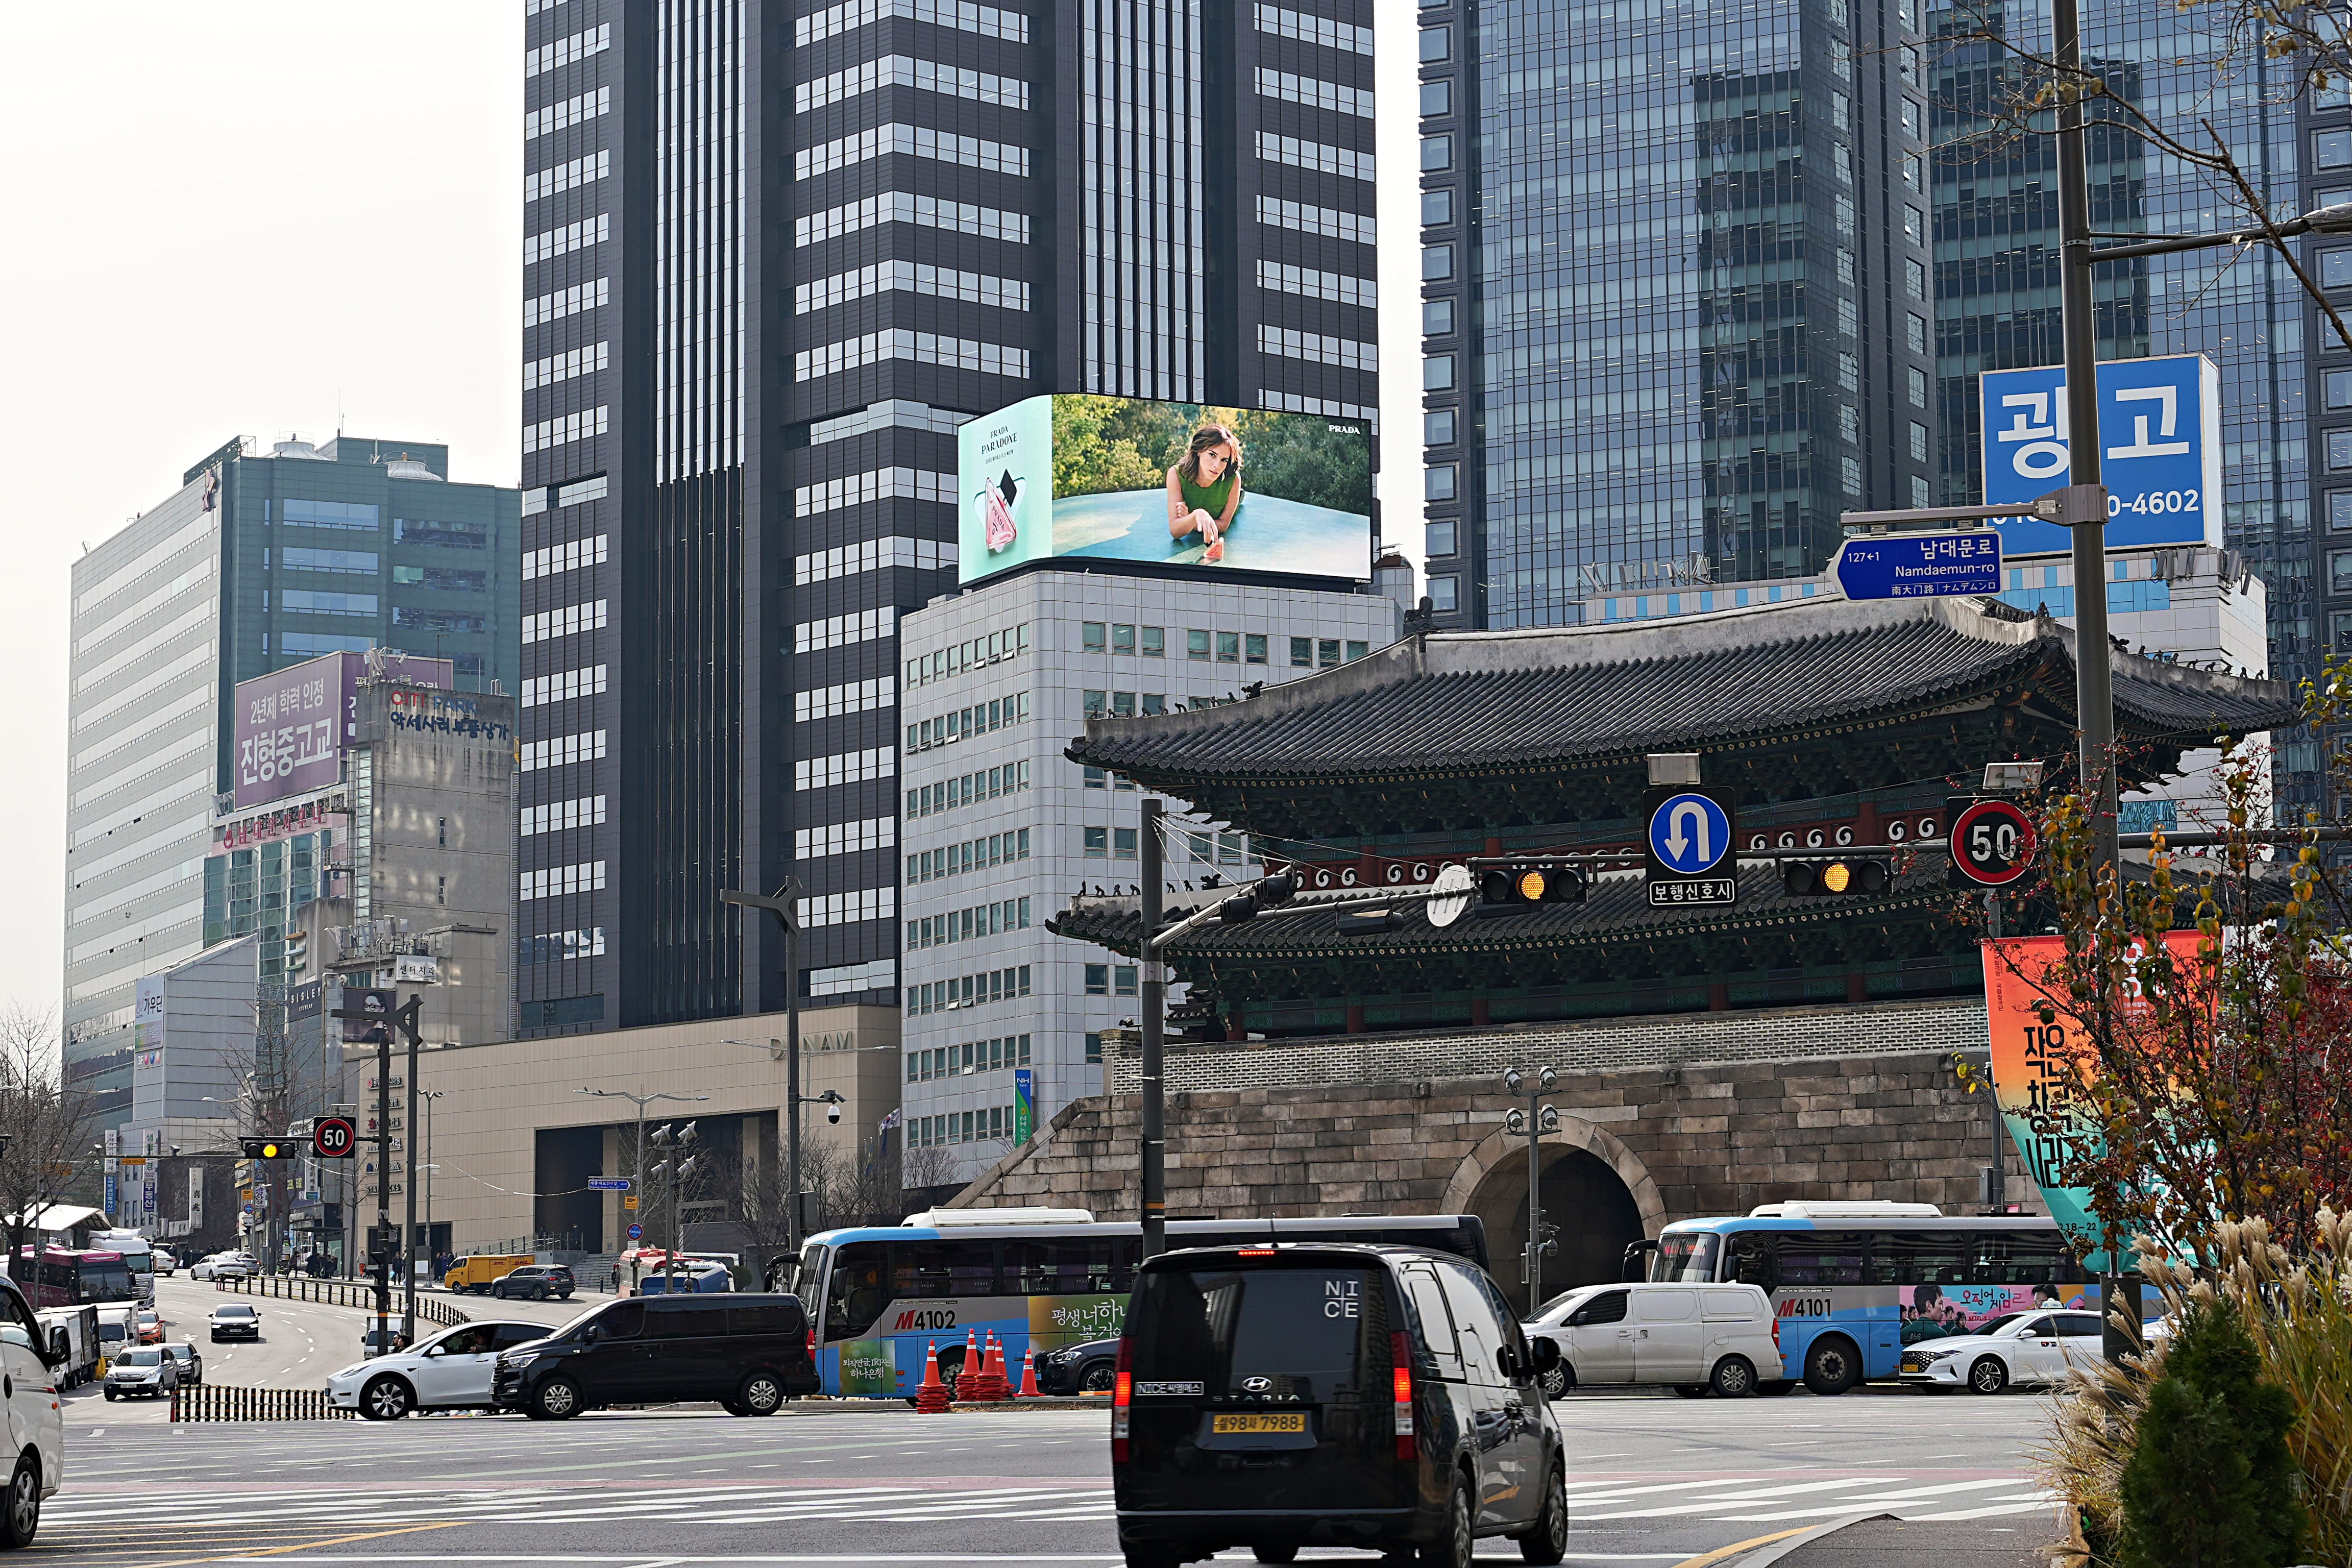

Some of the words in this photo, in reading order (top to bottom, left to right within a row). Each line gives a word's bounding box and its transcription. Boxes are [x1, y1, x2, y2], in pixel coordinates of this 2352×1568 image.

[990, 426, 1008, 438] PRADA
[1329, 425, 1360, 434] PRADA
[982, 432, 1017, 454] PARADOXE
[1921, 539, 1994, 560] 남대문로
[1895, 564, 1995, 577] Namdaemun-ro
[1892, 585, 1934, 596] 南大门路
[251, 692, 276, 724] 2년제
[280, 685, 300, 716] 학력
[303, 677, 324, 709] 인정
[391, 691, 425, 707] CITI
[434, 695, 478, 715] PARK
[390, 712, 450, 735] 악세사리
[240, 718, 333, 786] 진형중고교
[238, 804, 322, 845] 남대문사우나
[1972, 824, 2016, 861] 50
[1655, 883, 1730, 900] 보행신호시
[399, 965, 435, 975] 센터치과
[291, 987, 321, 1003] SISLEY
[299, 1003, 313, 1012] EYEWEAR
[770, 1031, 852, 1060] DNAM
[324, 1129, 345, 1146] 50
[1961, 1288, 1994, 1306] 오징어
[1990, 1288, 2011, 1312] 게임
[1777, 1298, 1831, 1316] M4101
[894, 1310, 956, 1330] M4102
[1051, 1307, 1080, 1327] 평생
[1908, 1333, 1922, 1341] 456
[850, 1367, 884, 1379] 하나은행
[1260, 1416, 1300, 1431] 7988
